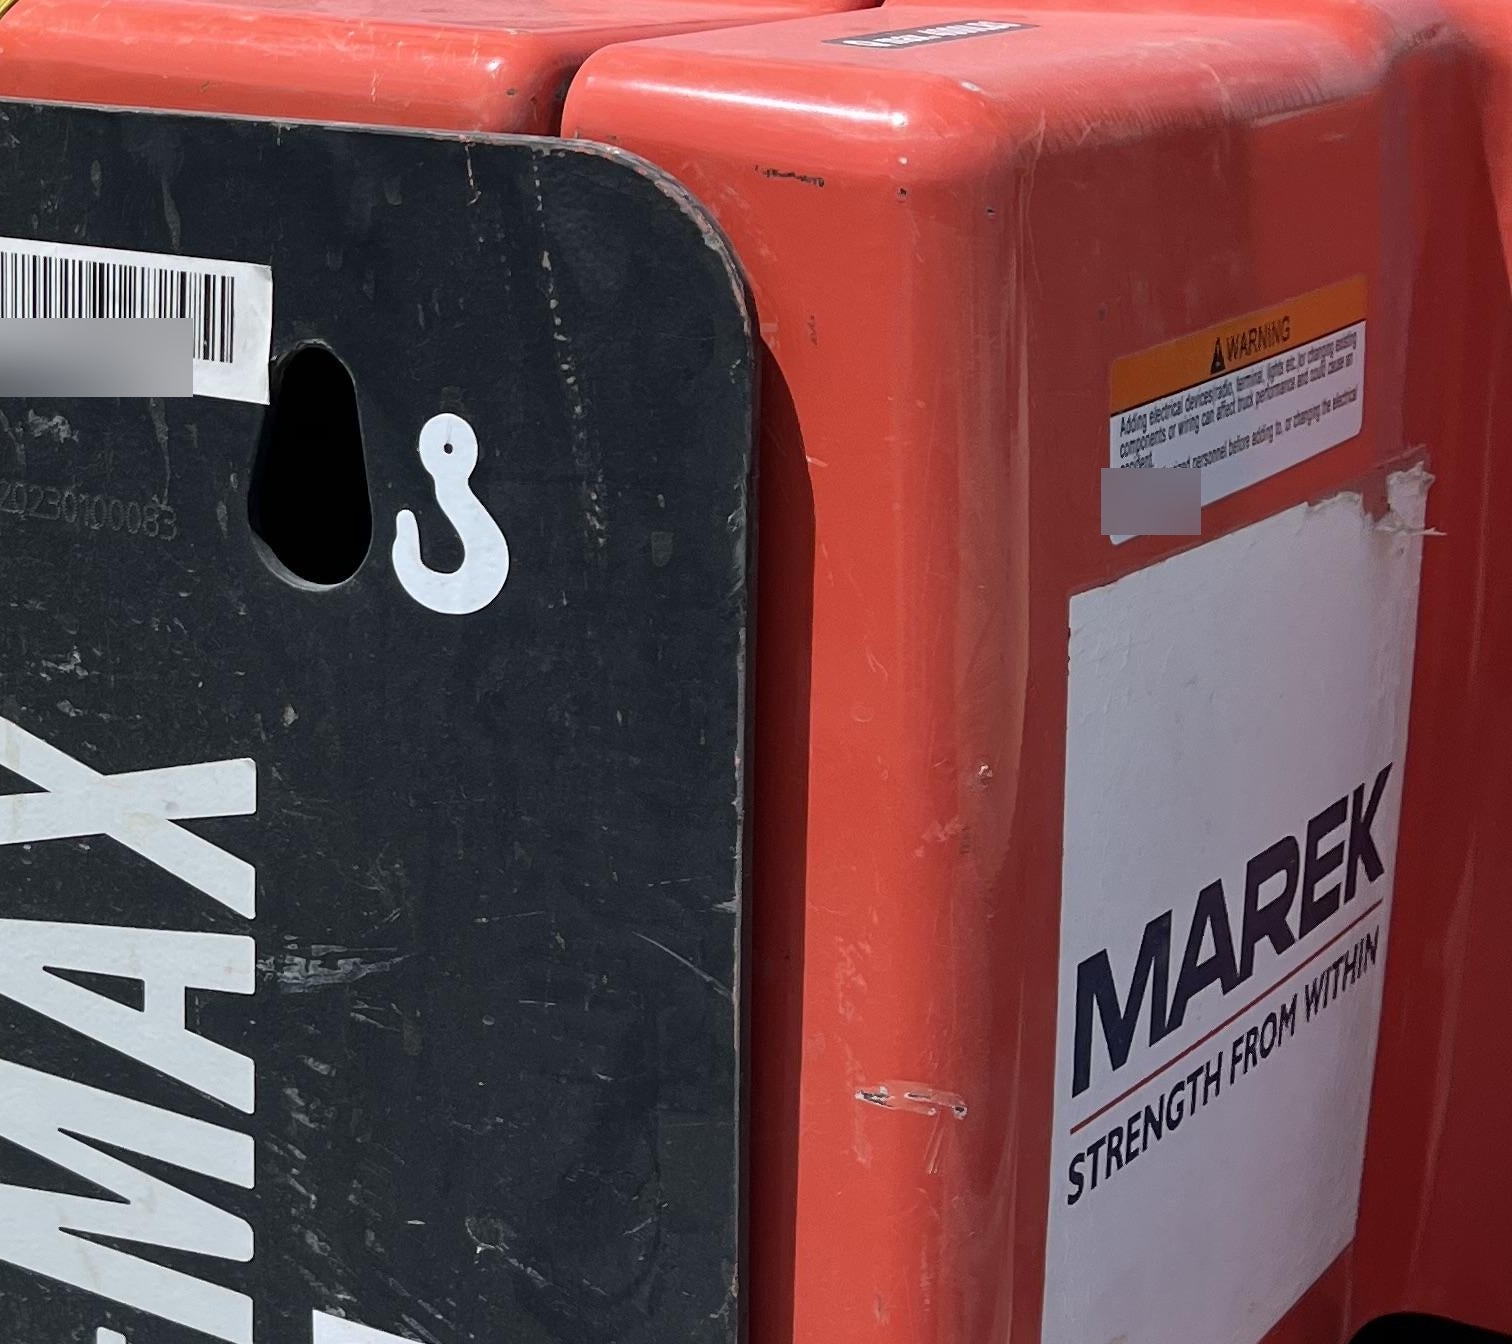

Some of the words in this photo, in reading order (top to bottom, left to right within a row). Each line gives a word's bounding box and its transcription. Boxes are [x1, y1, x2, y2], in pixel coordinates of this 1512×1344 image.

[1226, 315, 1290, 362] WARNING
[1120, 413, 1148, 437] Adding
[1120, 427, 1167, 459] components
[1168, 423, 1177, 440] or
[1178, 414, 1200, 435] wiring
[1201, 409, 1215, 427] can
[1072, 761, 1393, 1099] MAREK
[1067, 1051, 1224, 1206] STRENGTH
[1229, 993, 1298, 1086] FROM
[1303, 924, 1381, 1023] WITHIN
